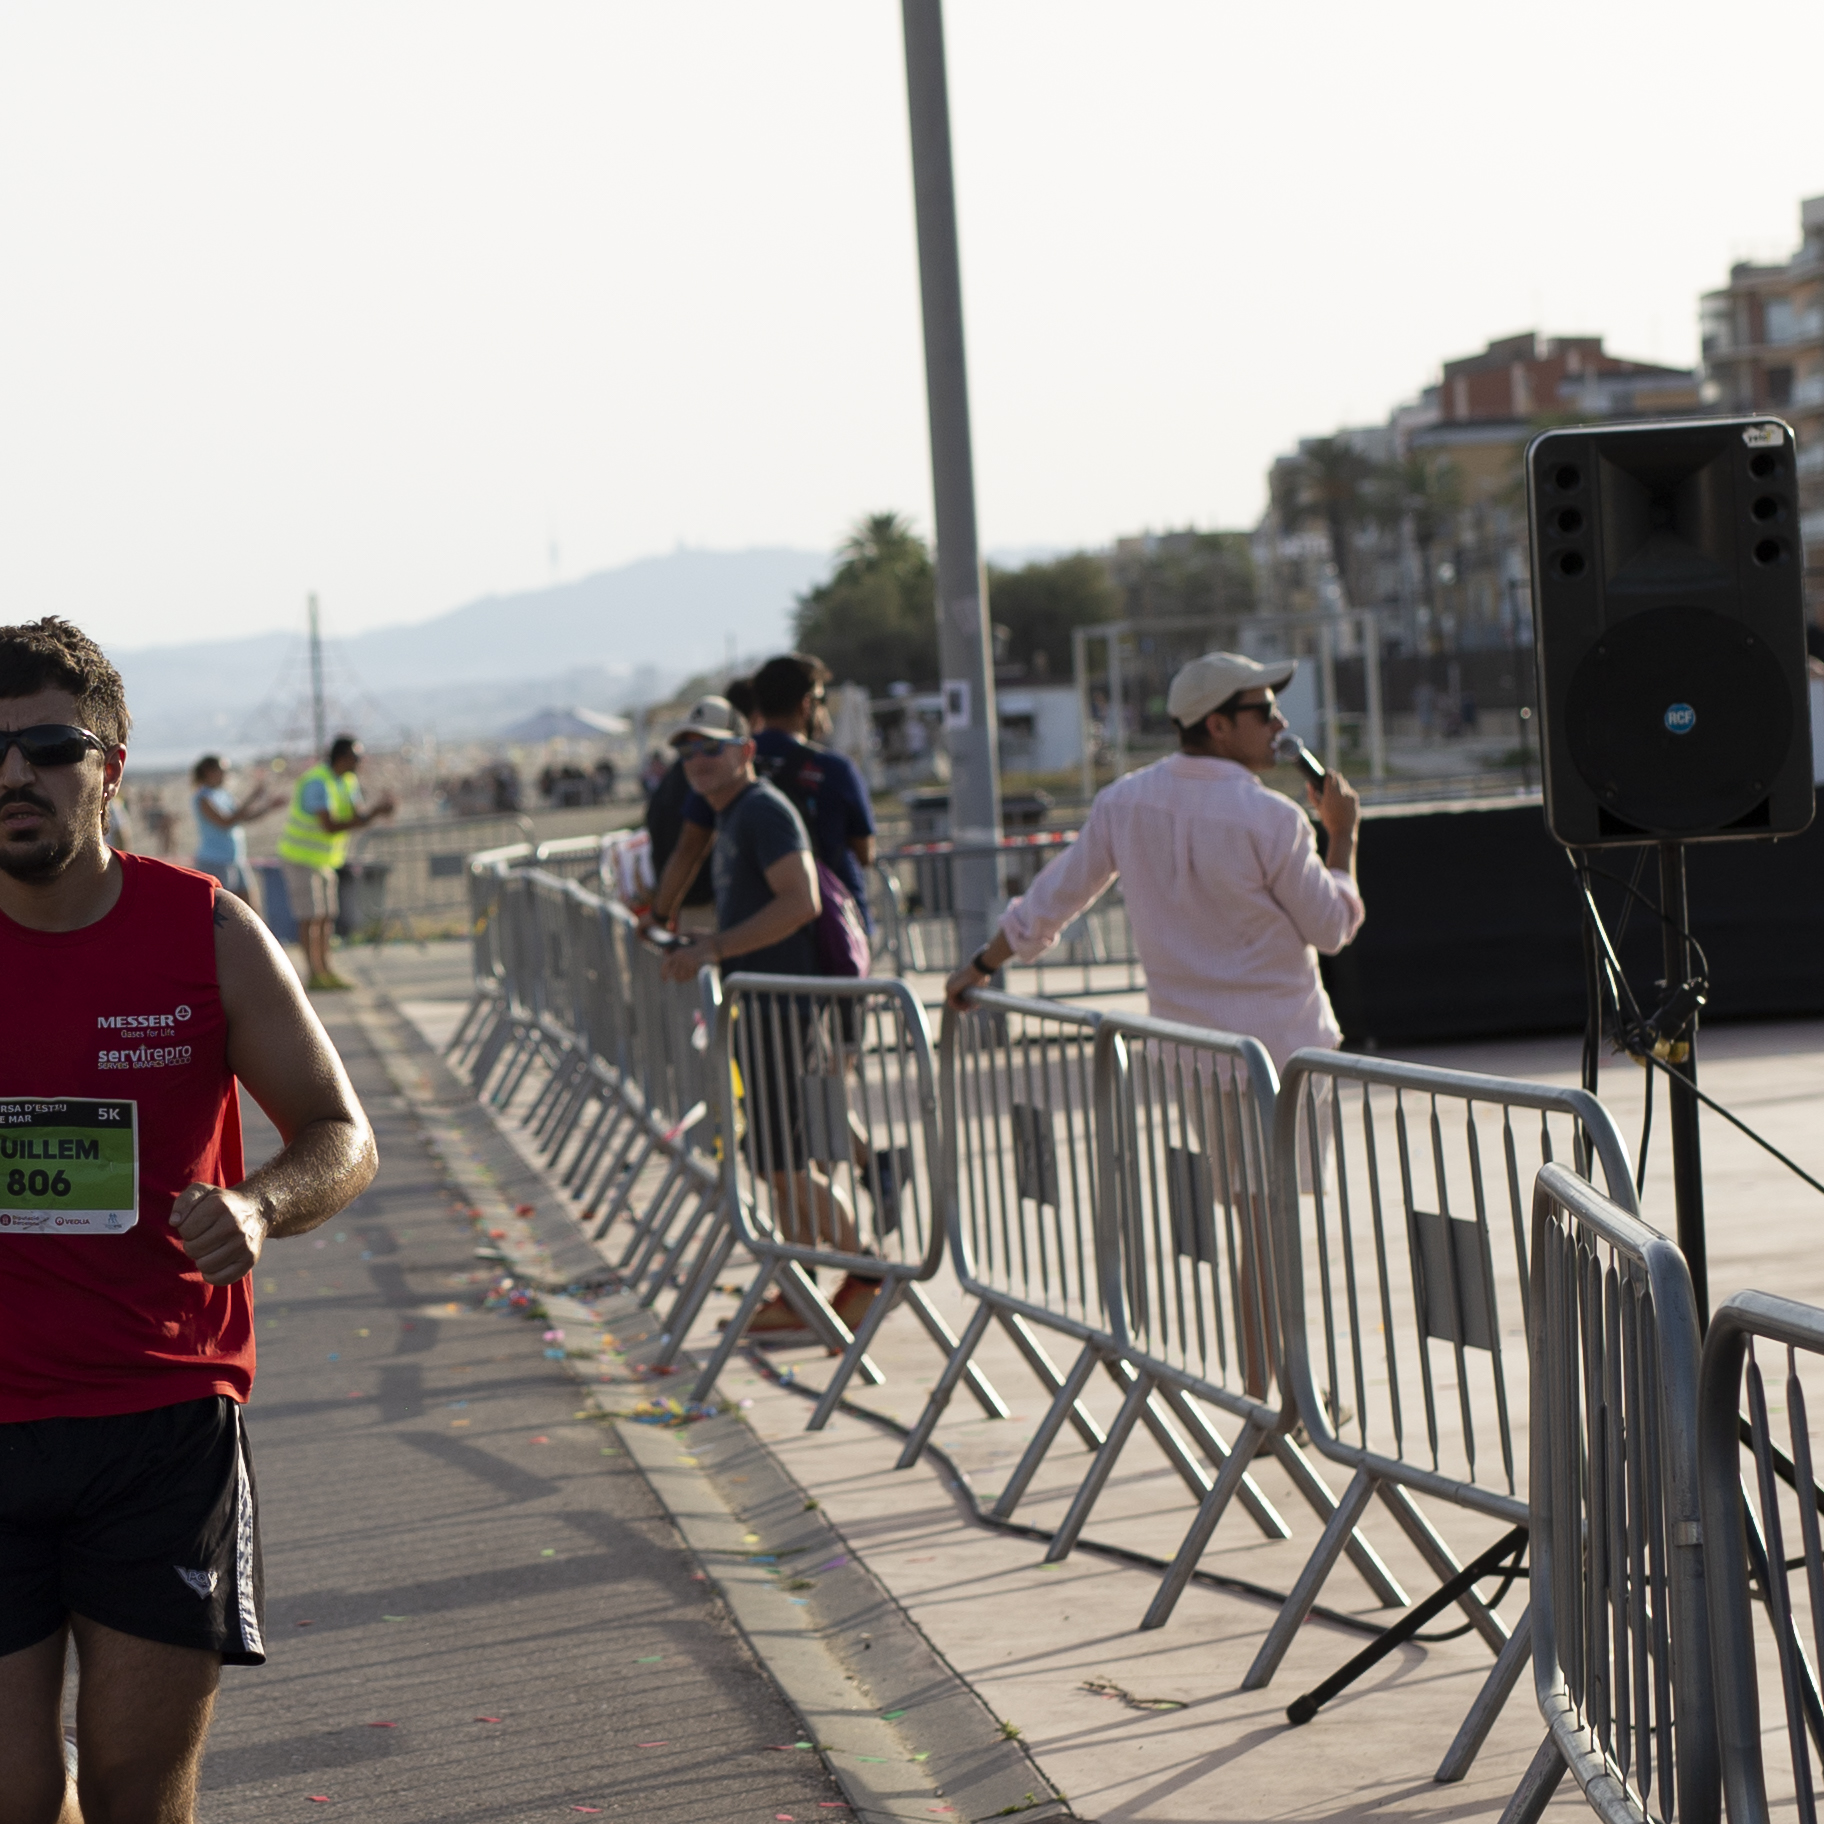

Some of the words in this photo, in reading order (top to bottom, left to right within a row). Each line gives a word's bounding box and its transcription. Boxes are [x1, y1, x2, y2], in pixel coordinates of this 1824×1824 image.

[1668, 709, 1693, 725] RCF
[97, 1014, 175, 1029] MESSER
[120, 1029, 145, 1038] Gases
[146, 1028, 159, 1037] for
[160, 1028, 175, 1037] Life
[98, 1043, 192, 1064] servirepro
[8, 1114, 32, 1124] MAR
[98, 1108, 121, 1121] 5K
[6, 1168, 72, 1197] 806
